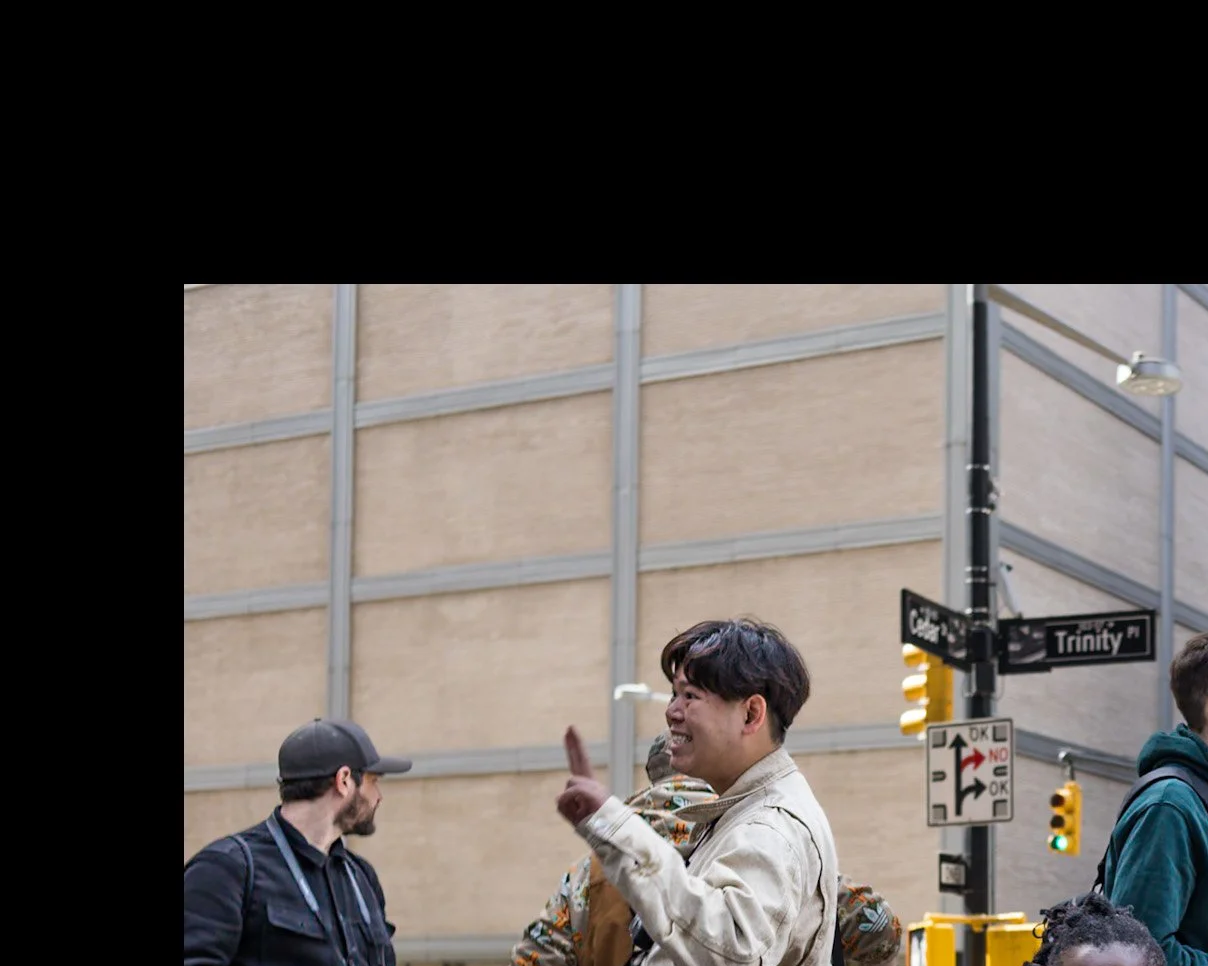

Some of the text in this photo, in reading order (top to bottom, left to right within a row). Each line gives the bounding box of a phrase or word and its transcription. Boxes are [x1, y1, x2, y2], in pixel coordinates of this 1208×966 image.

[909, 608, 940, 644] Cedar
[1055, 628, 1123, 655] Trinity
[969, 726, 989, 741] OK
[989, 747, 1009, 762] NO
[989, 780, 1009, 796] OK
